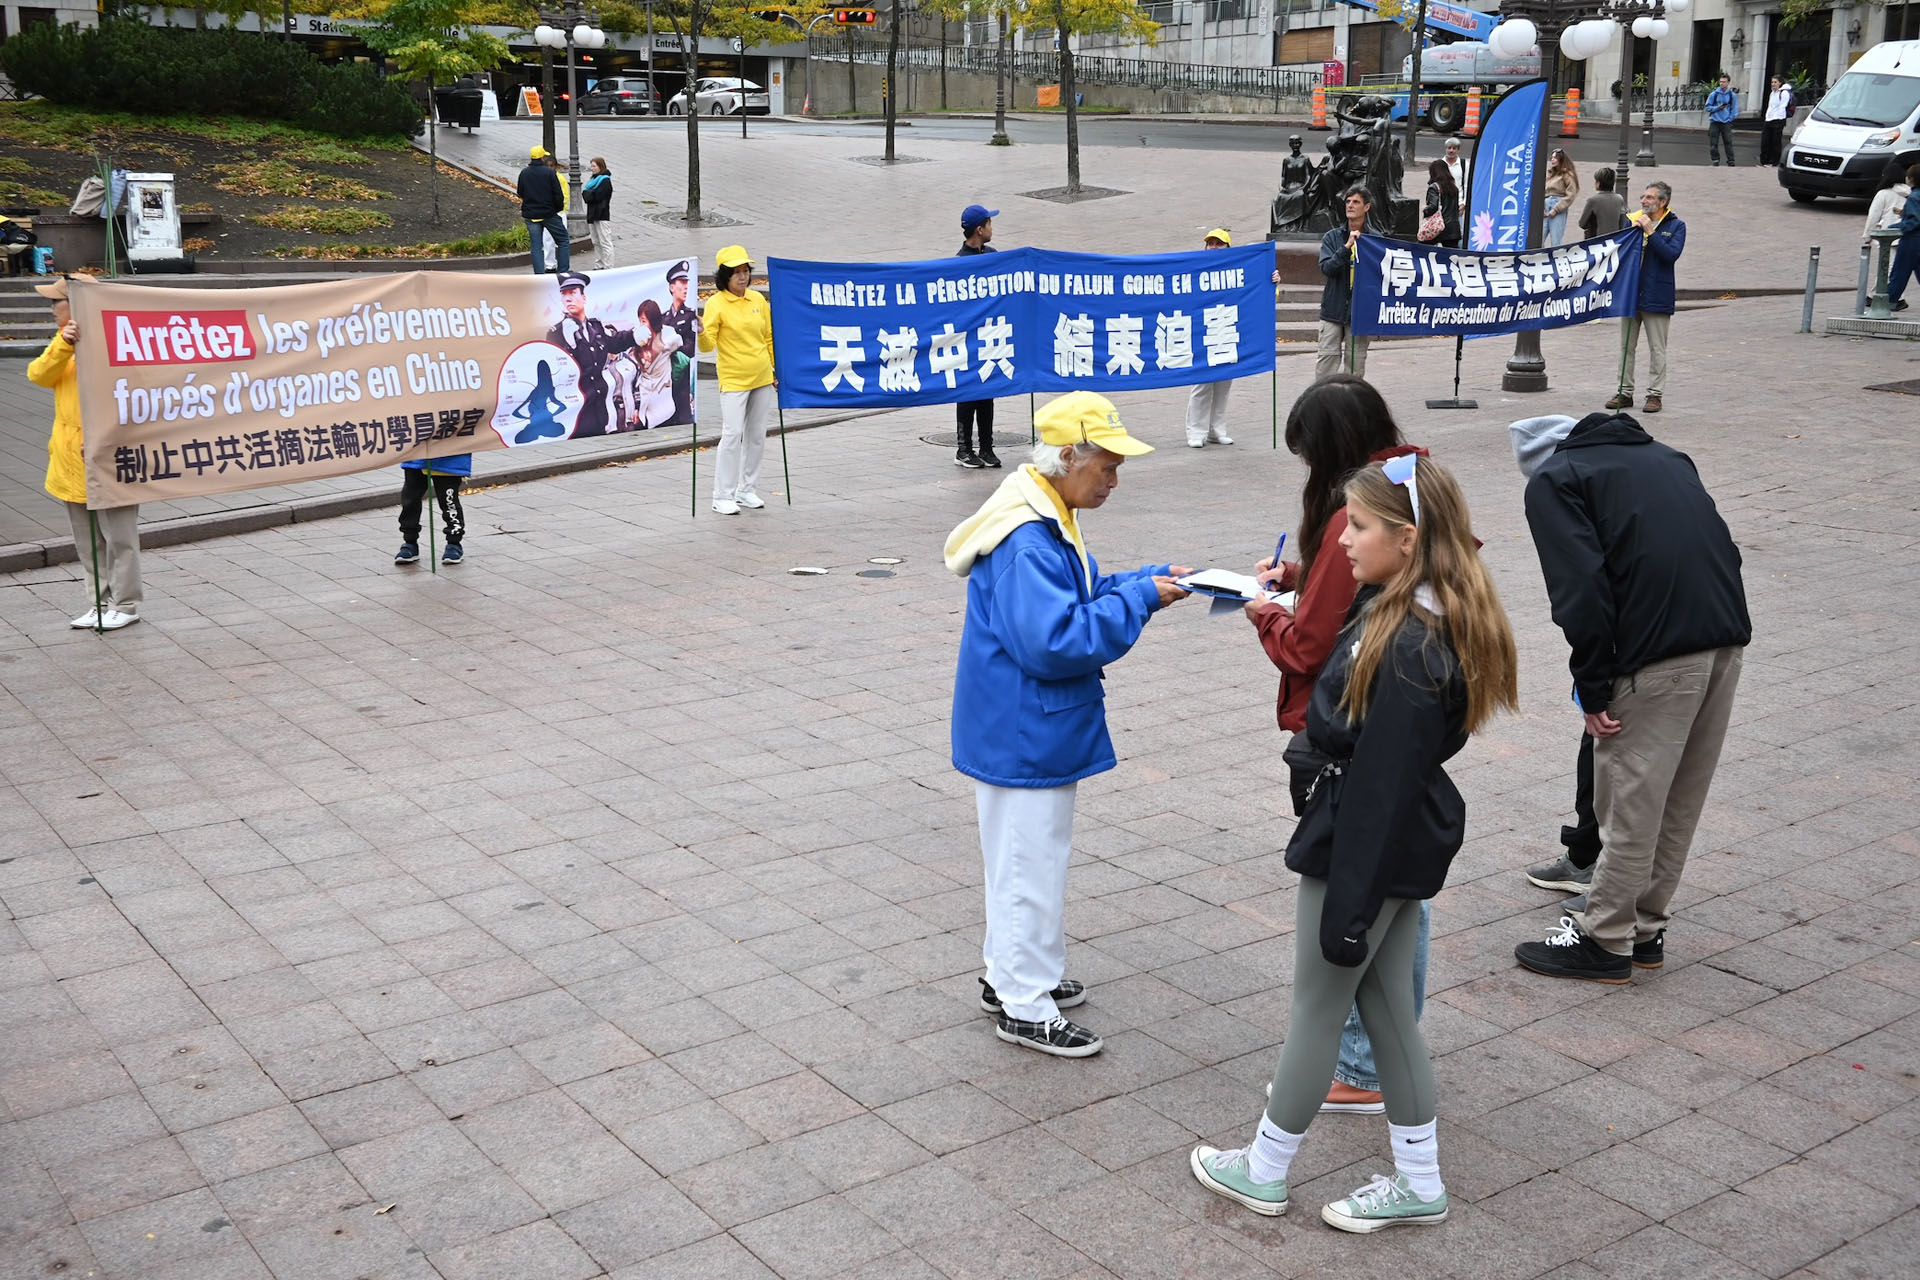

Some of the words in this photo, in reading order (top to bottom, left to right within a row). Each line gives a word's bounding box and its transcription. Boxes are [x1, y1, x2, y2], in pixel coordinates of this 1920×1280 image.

[655, 38, 681, 49] Entrée
[1500, 143, 1526, 216] DAFA
[811, 280, 886, 307] ARRÊTEZ
[896, 283, 917, 305] LA
[1039, 273, 1060, 295] DU
[1064, 273, 1114, 295] FALUN
[1122, 274, 1165, 295] GONG
[1171, 273, 1192, 294] EN
[1199, 268, 1245, 291] CHINE
[1379, 239, 1622, 298] 停止迫害法輪功
[115, 315, 251, 361] Arrêtez
[257, 313, 310, 354] les
[317, 299, 511, 358] prélèvements
[1378, 301, 1417, 324] Arrêtez
[1419, 303, 1431, 324] la
[1432, 302, 1498, 328] persécution
[1498, 302, 1513, 322] du
[1513, 300, 1542, 320] Falun
[1543, 297, 1571, 320] Gong
[1573, 296, 1587, 314] en
[113, 373, 217, 425] forcés
[223, 371, 362, 418] d'organes
[367, 365, 402, 399] en
[405, 352, 482, 395] Chine
[114, 407, 486, 484] 制止中共活摘法輪功學員器官
